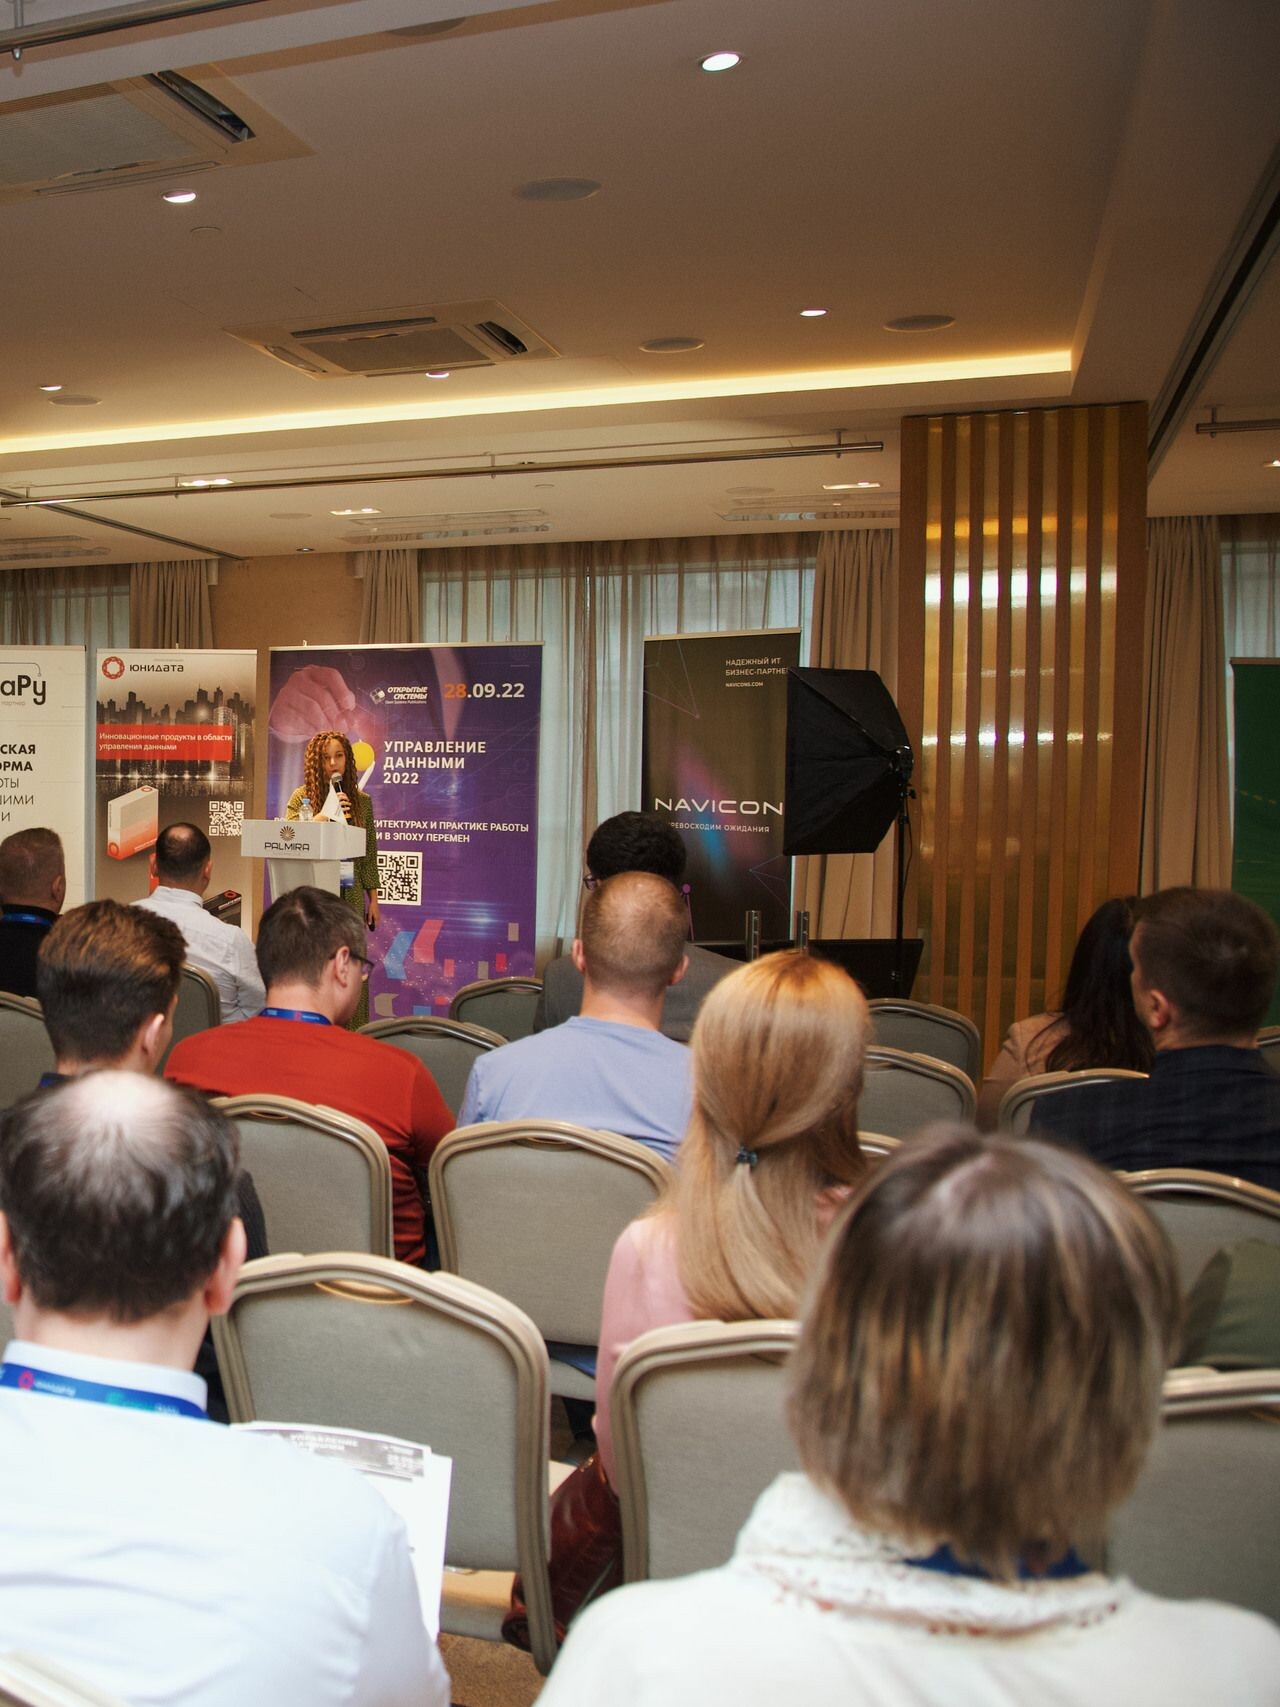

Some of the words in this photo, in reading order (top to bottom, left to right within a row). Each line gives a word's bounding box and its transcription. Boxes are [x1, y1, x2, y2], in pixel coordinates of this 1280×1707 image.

[725, 657, 769, 666] НАДЕЖНЫЙ
[443, 682, 525, 698] 28.09.22
[99, 733, 159, 741] Инновационные
[160, 734, 196, 742] продукты
[203, 733, 232, 741] области
[99, 743, 142, 751] управления
[384, 741, 486, 753] УПРАВЛЕНИЕ
[383, 757, 465, 770] ДАННЫМИ
[383, 772, 419, 784] 2022
[654, 798, 783, 815] NAVICON
[430, 820, 437, 829] И
[439, 821, 488, 831] ПРАКТИКЕ
[490, 823, 529, 832] РАБОТЫ
[668, 822, 721, 831] РЕВОСХОДИМ
[724, 824, 770, 833] ОЖИДАНИЯ
[385, 832, 391, 840] В
[393, 832, 424, 841] ЭПОХУ
[426, 834, 470, 843] ПЕРЕМЕН
[264, 842, 310, 851] PALMIRA
